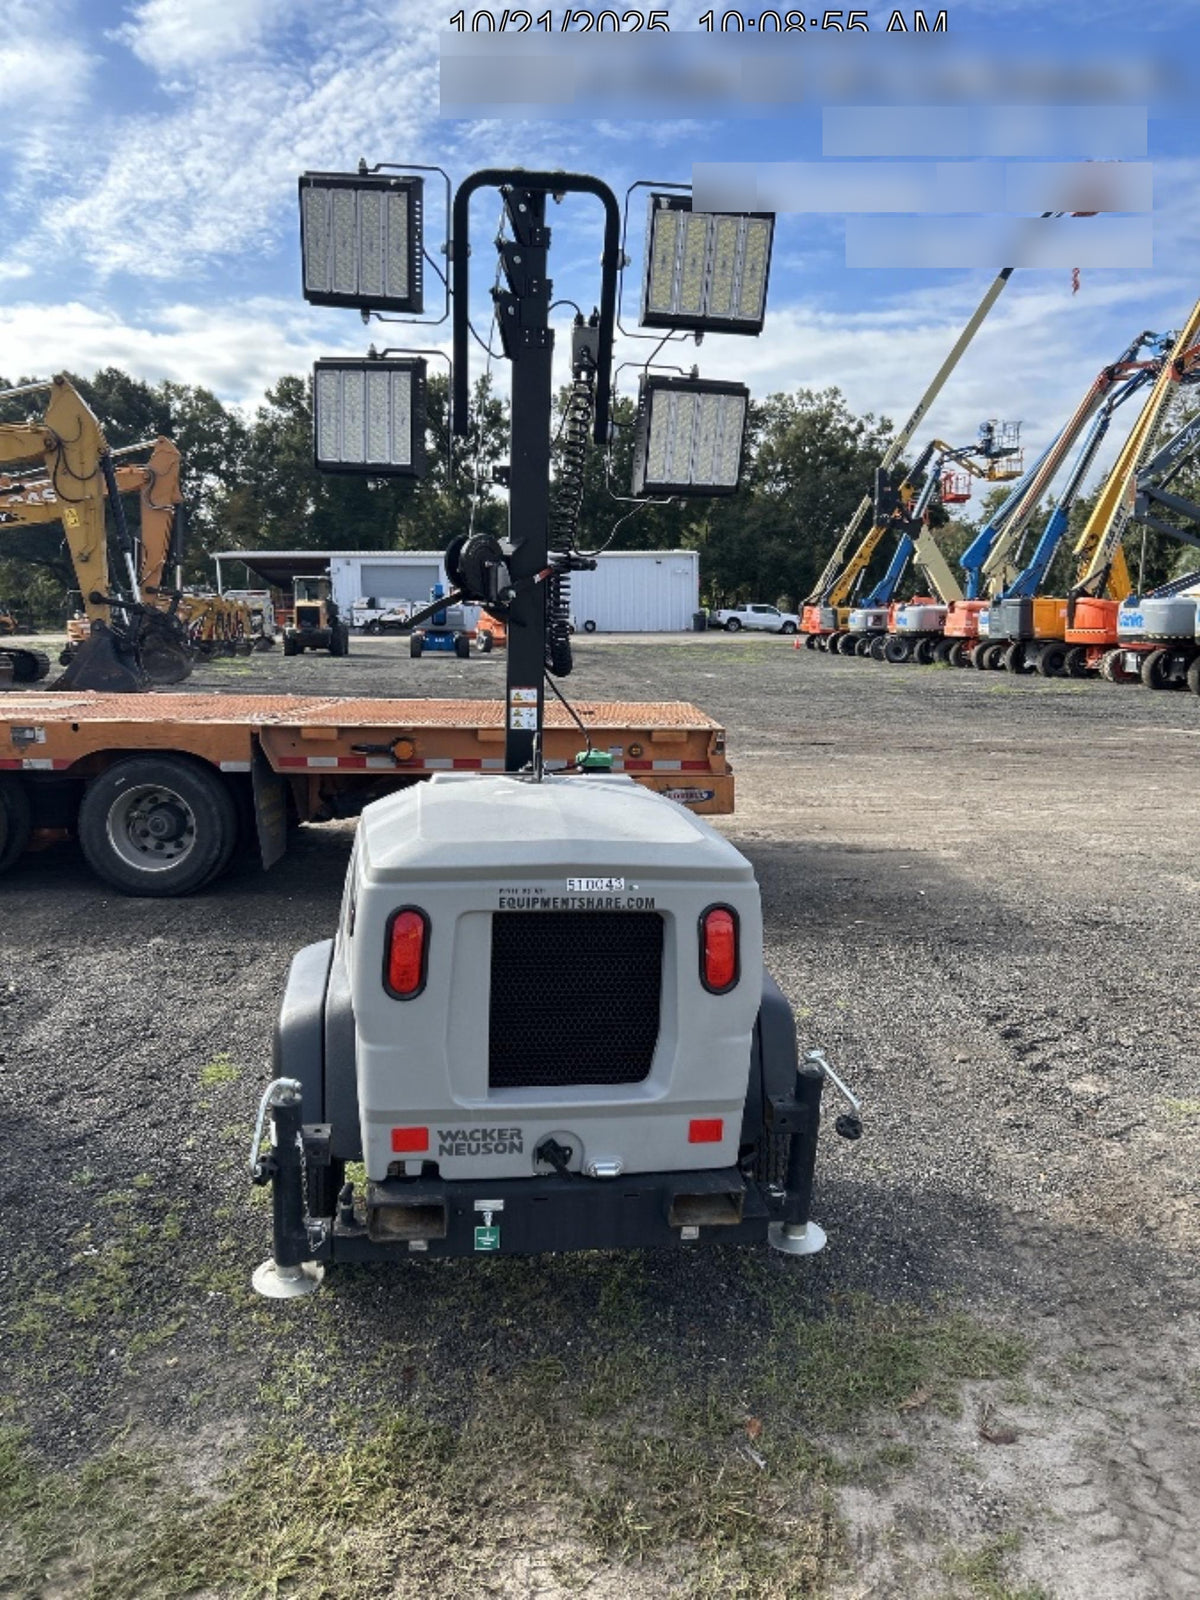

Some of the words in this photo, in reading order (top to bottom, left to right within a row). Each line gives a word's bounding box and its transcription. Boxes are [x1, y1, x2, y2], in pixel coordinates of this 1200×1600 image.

[499, 896, 656, 909] EQUIPMENTSHARE.COM
[437, 1128, 523, 1143] WACKER
[438, 1141, 523, 1156] NEUSON
